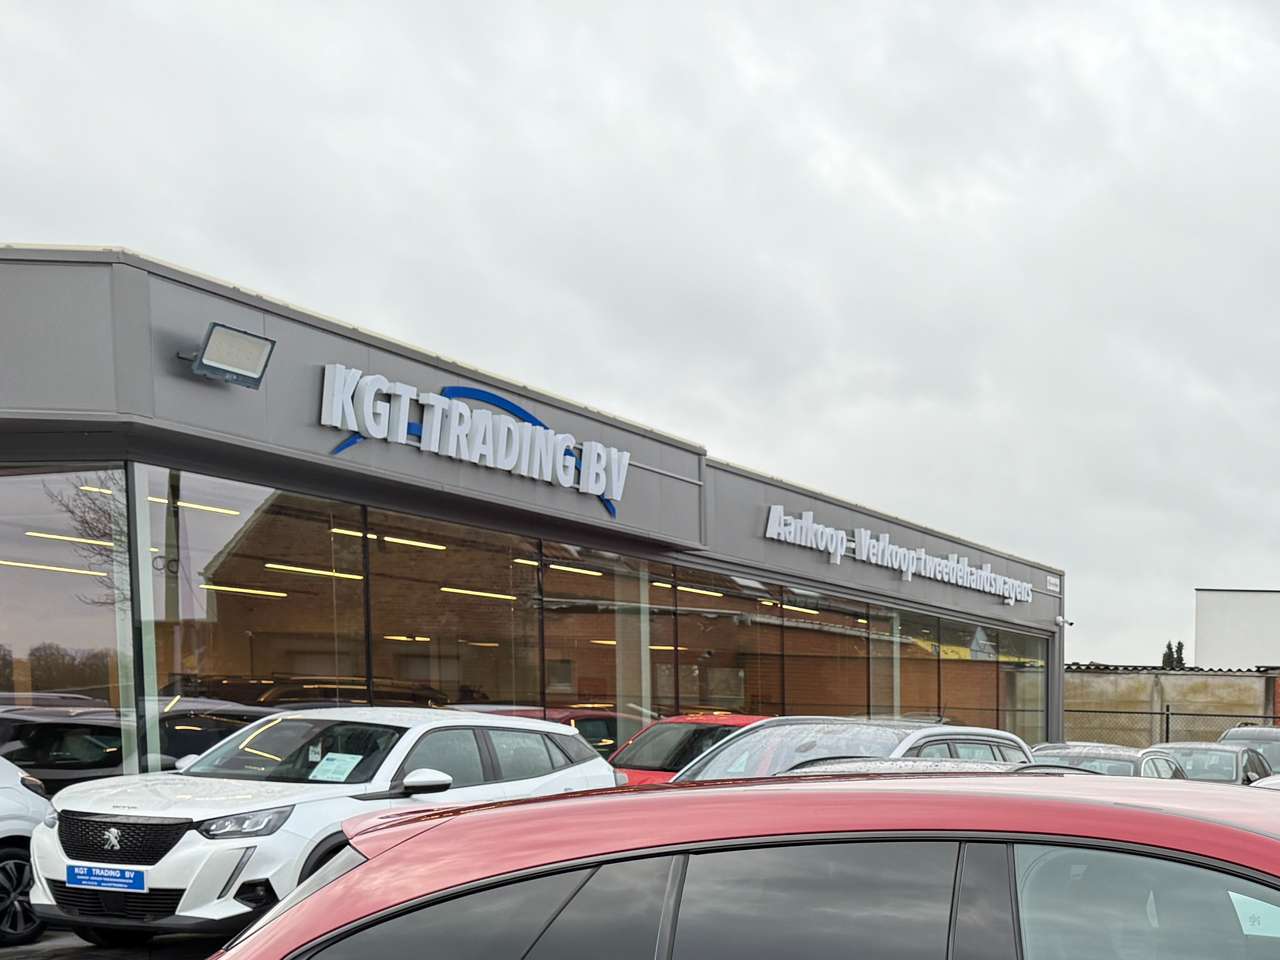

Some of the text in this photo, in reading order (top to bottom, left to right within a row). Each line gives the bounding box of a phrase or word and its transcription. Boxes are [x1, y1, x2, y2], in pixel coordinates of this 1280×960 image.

[320, 363, 631, 502] KGT TRADING BV
[74, 867, 88, 875] KGT
[92, 868, 121, 878] TRADING
